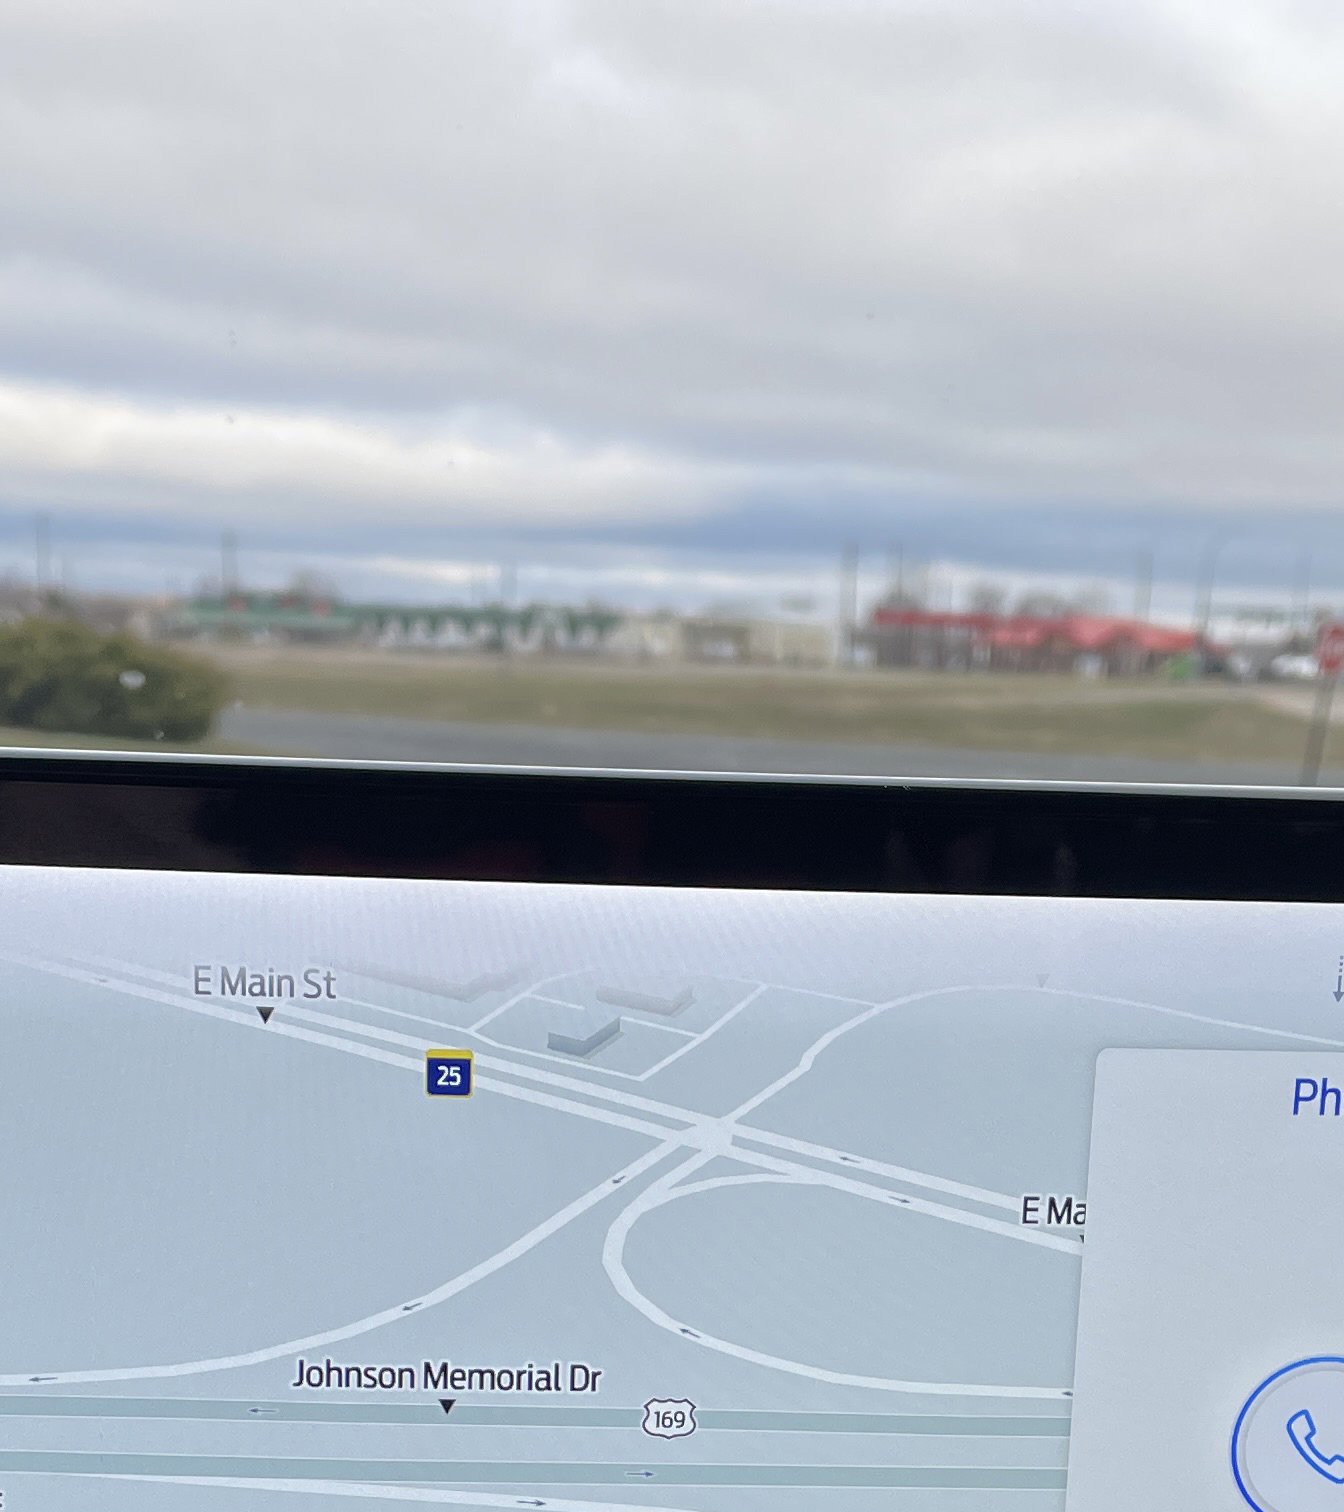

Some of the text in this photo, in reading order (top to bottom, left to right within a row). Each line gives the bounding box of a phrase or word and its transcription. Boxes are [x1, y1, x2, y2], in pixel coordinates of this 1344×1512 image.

[194, 966, 337, 1000] E Main St
[437, 1065, 461, 1086] 25
[1022, 1196, 1040, 1224] E
[293, 1360, 602, 1393] Johnson Memorial Dr
[653, 1409, 686, 1429] 169
